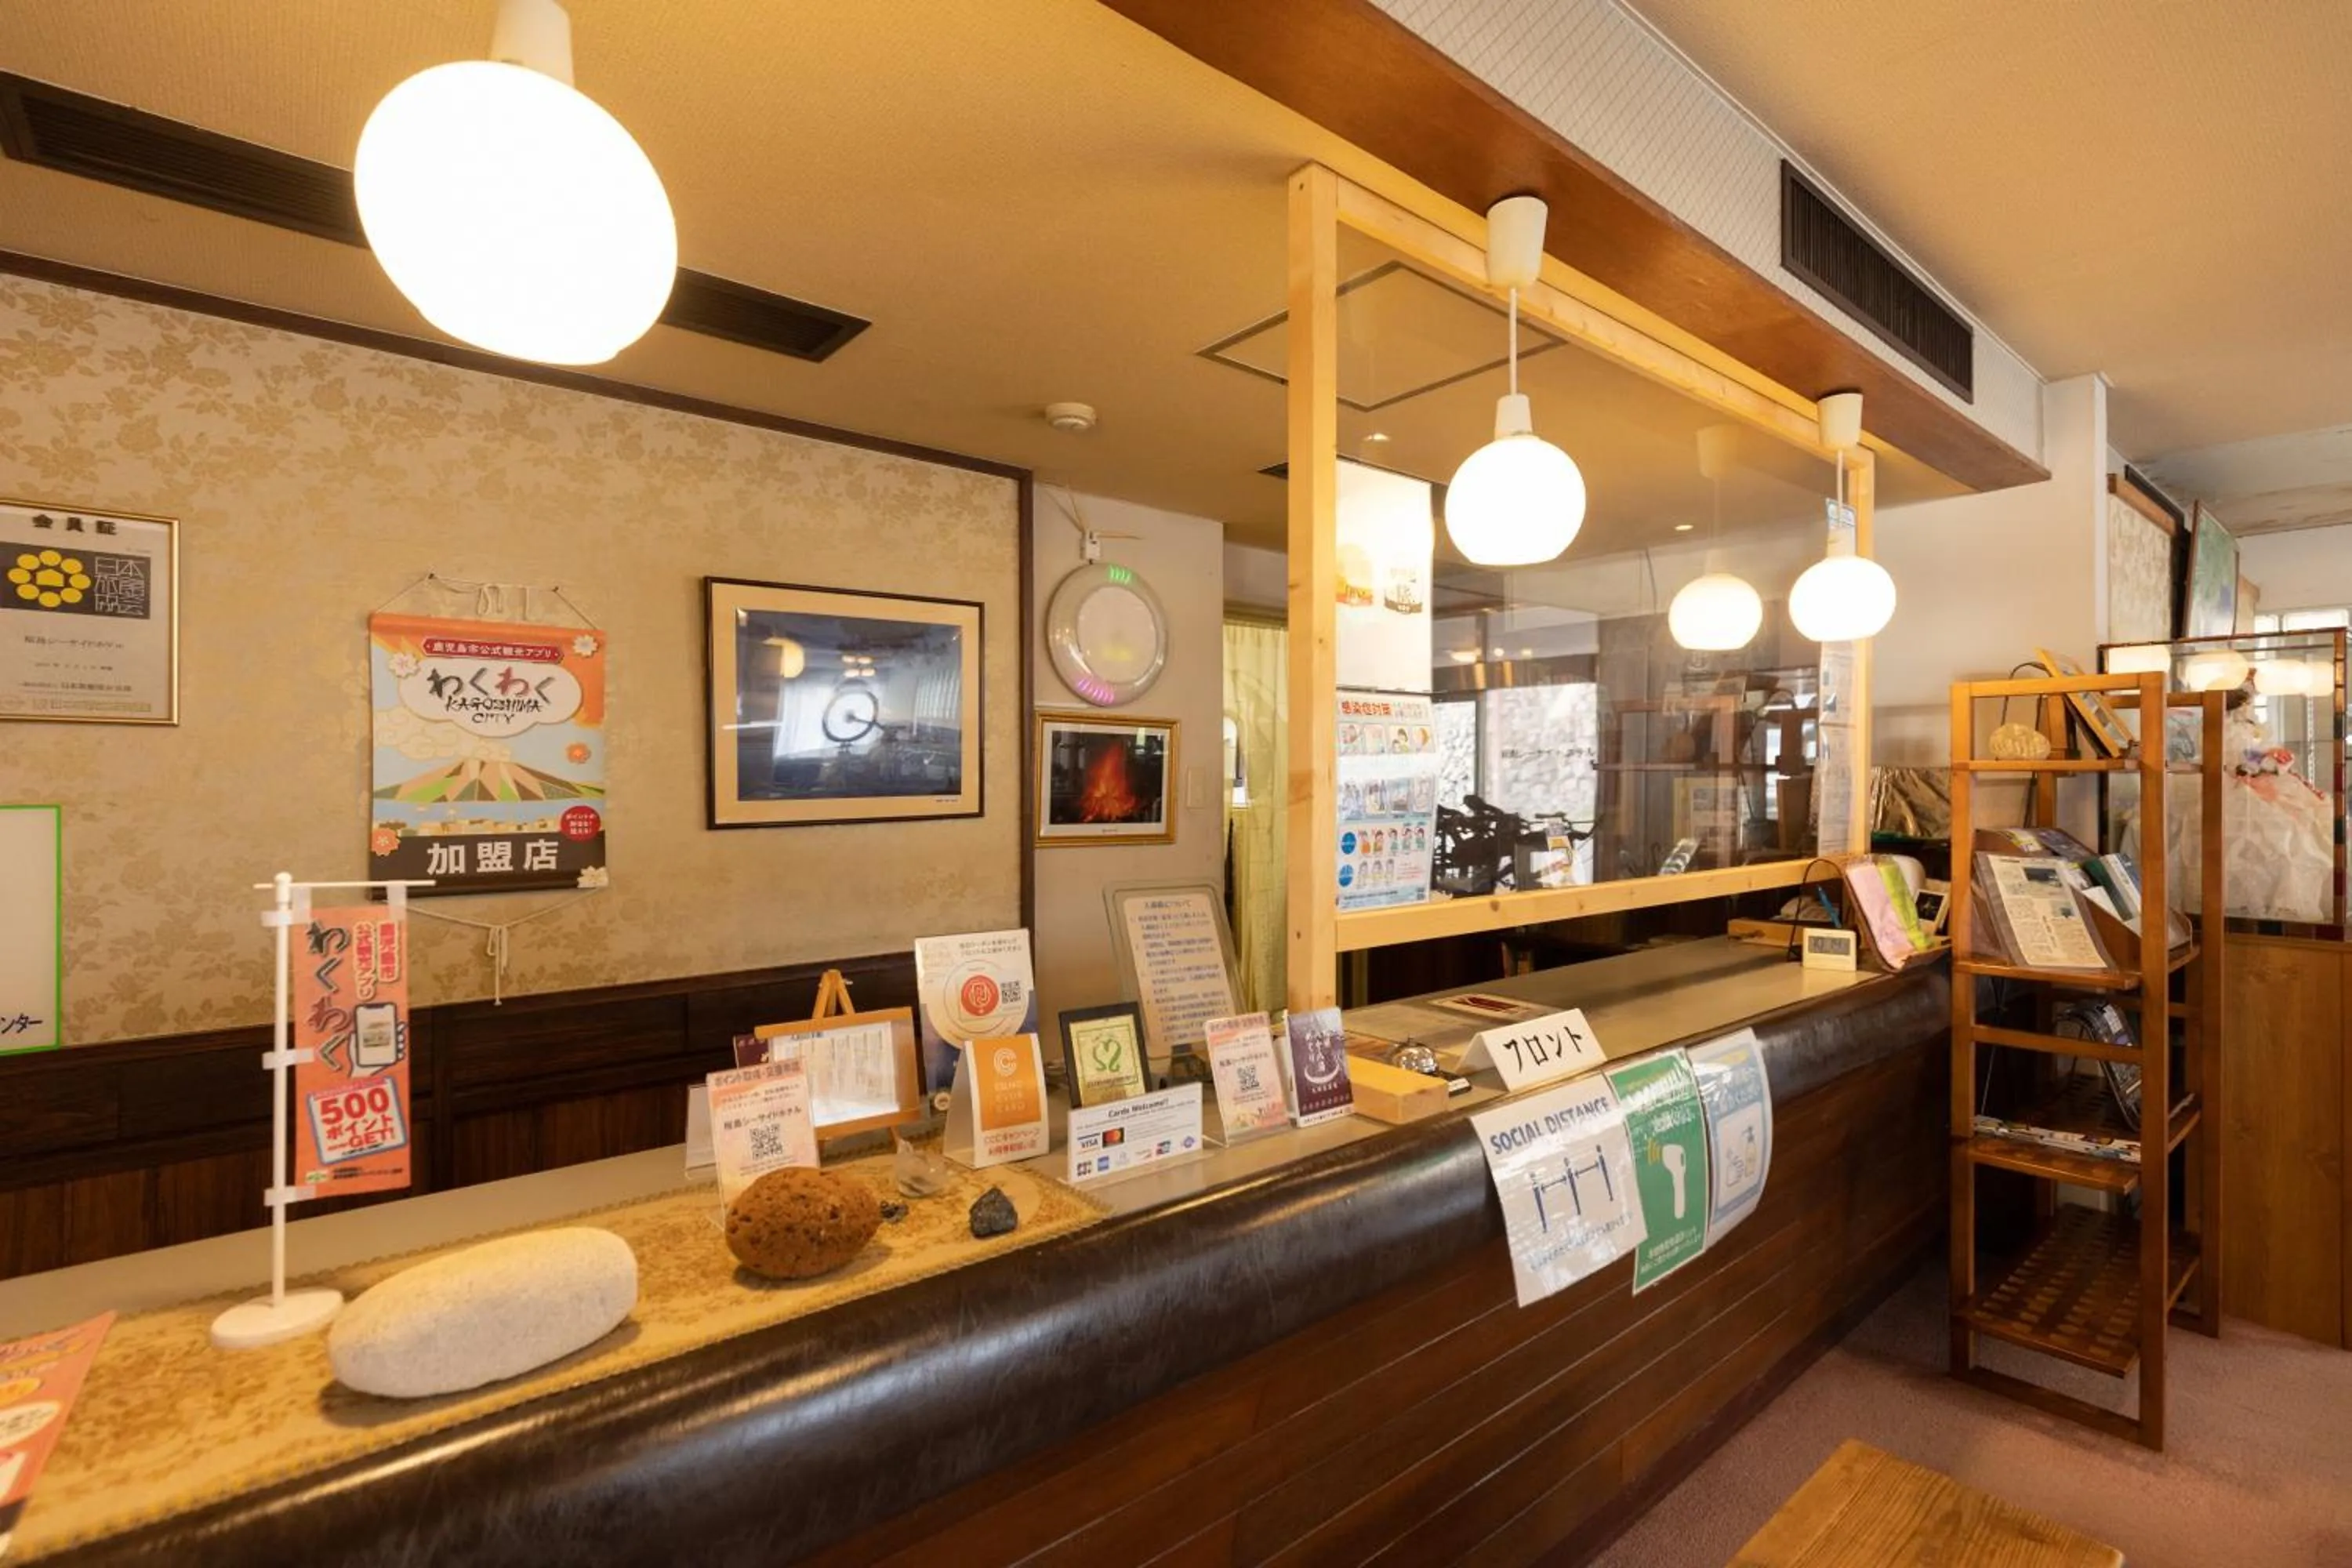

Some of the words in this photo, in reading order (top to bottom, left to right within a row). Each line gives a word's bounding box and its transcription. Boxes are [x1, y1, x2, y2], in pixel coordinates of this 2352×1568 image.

[32, 514, 117, 535] 会員証
[426, 666, 555, 704] わくわく
[445, 695, 543, 713] KAGOSHIMA
[471, 712, 515, 724] CITY
[426, 839, 559, 876] 加盟店
[306, 920, 353, 1073] わくわく
[1503, 1025, 1584, 1073] フロント
[320, 1087, 390, 1125] 500
[1108, 1107, 1131, 1118] Cards
[326, 1114, 393, 1140] ポイント
[1490, 1120, 1541, 1155] SOCIAL
[1544, 1097, 1611, 1135] DISTANCE
[1081, 1138, 1098, 1149] VISA
